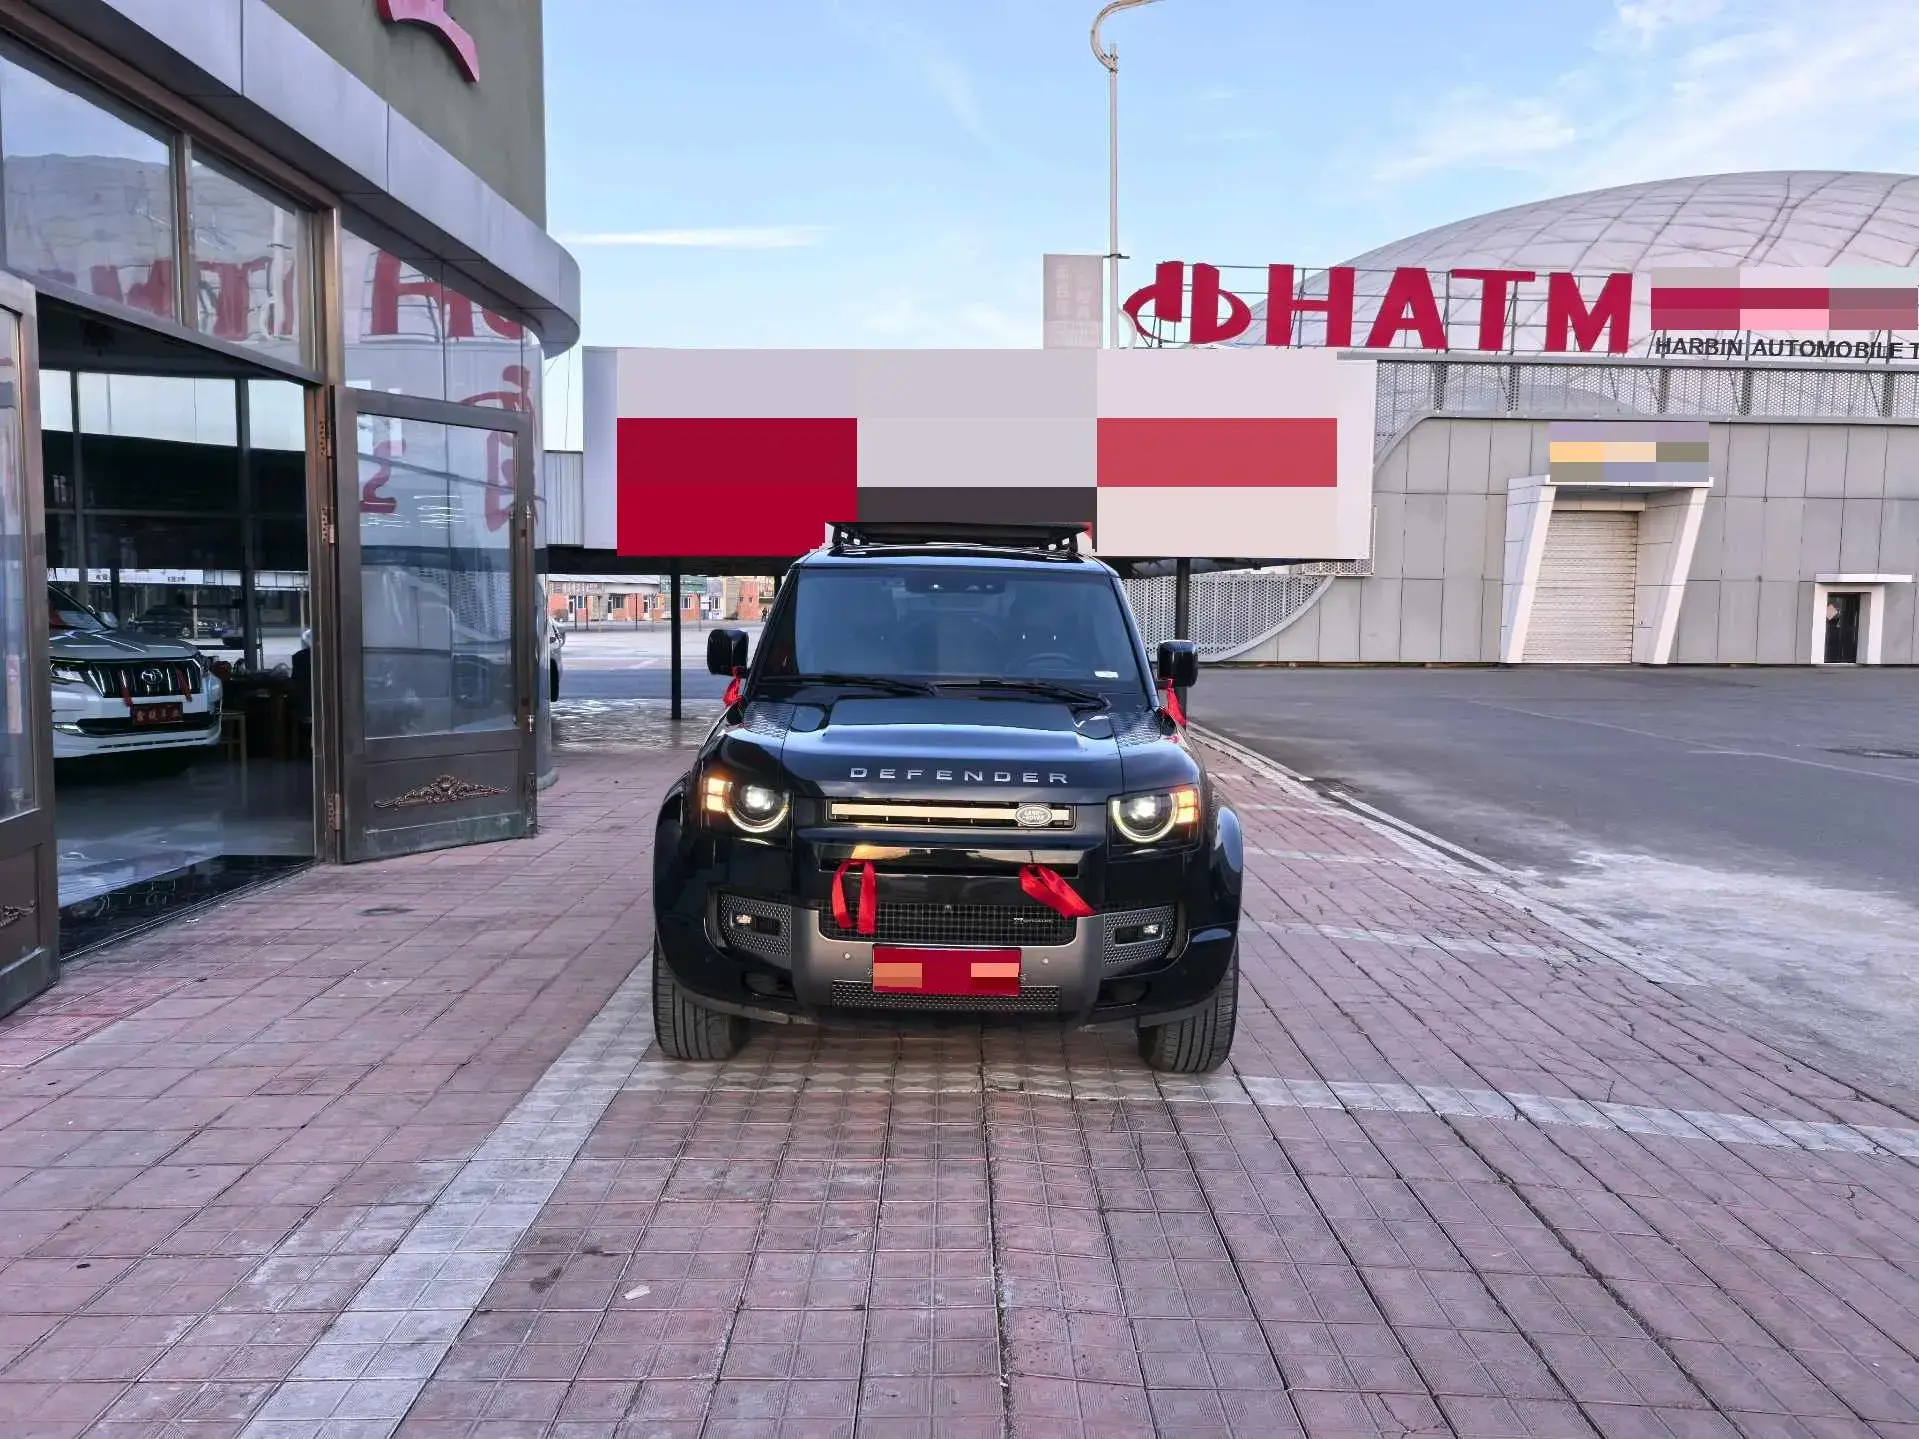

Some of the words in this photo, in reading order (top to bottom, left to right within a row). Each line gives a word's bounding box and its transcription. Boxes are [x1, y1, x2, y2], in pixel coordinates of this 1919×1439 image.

[1266, 263, 1633, 354] HATM
[1655, 337, 1742, 356] HARBIN
[1751, 339, 1903, 359] AUTOMOBILE
[850, 767, 1068, 784] DEFENDER
